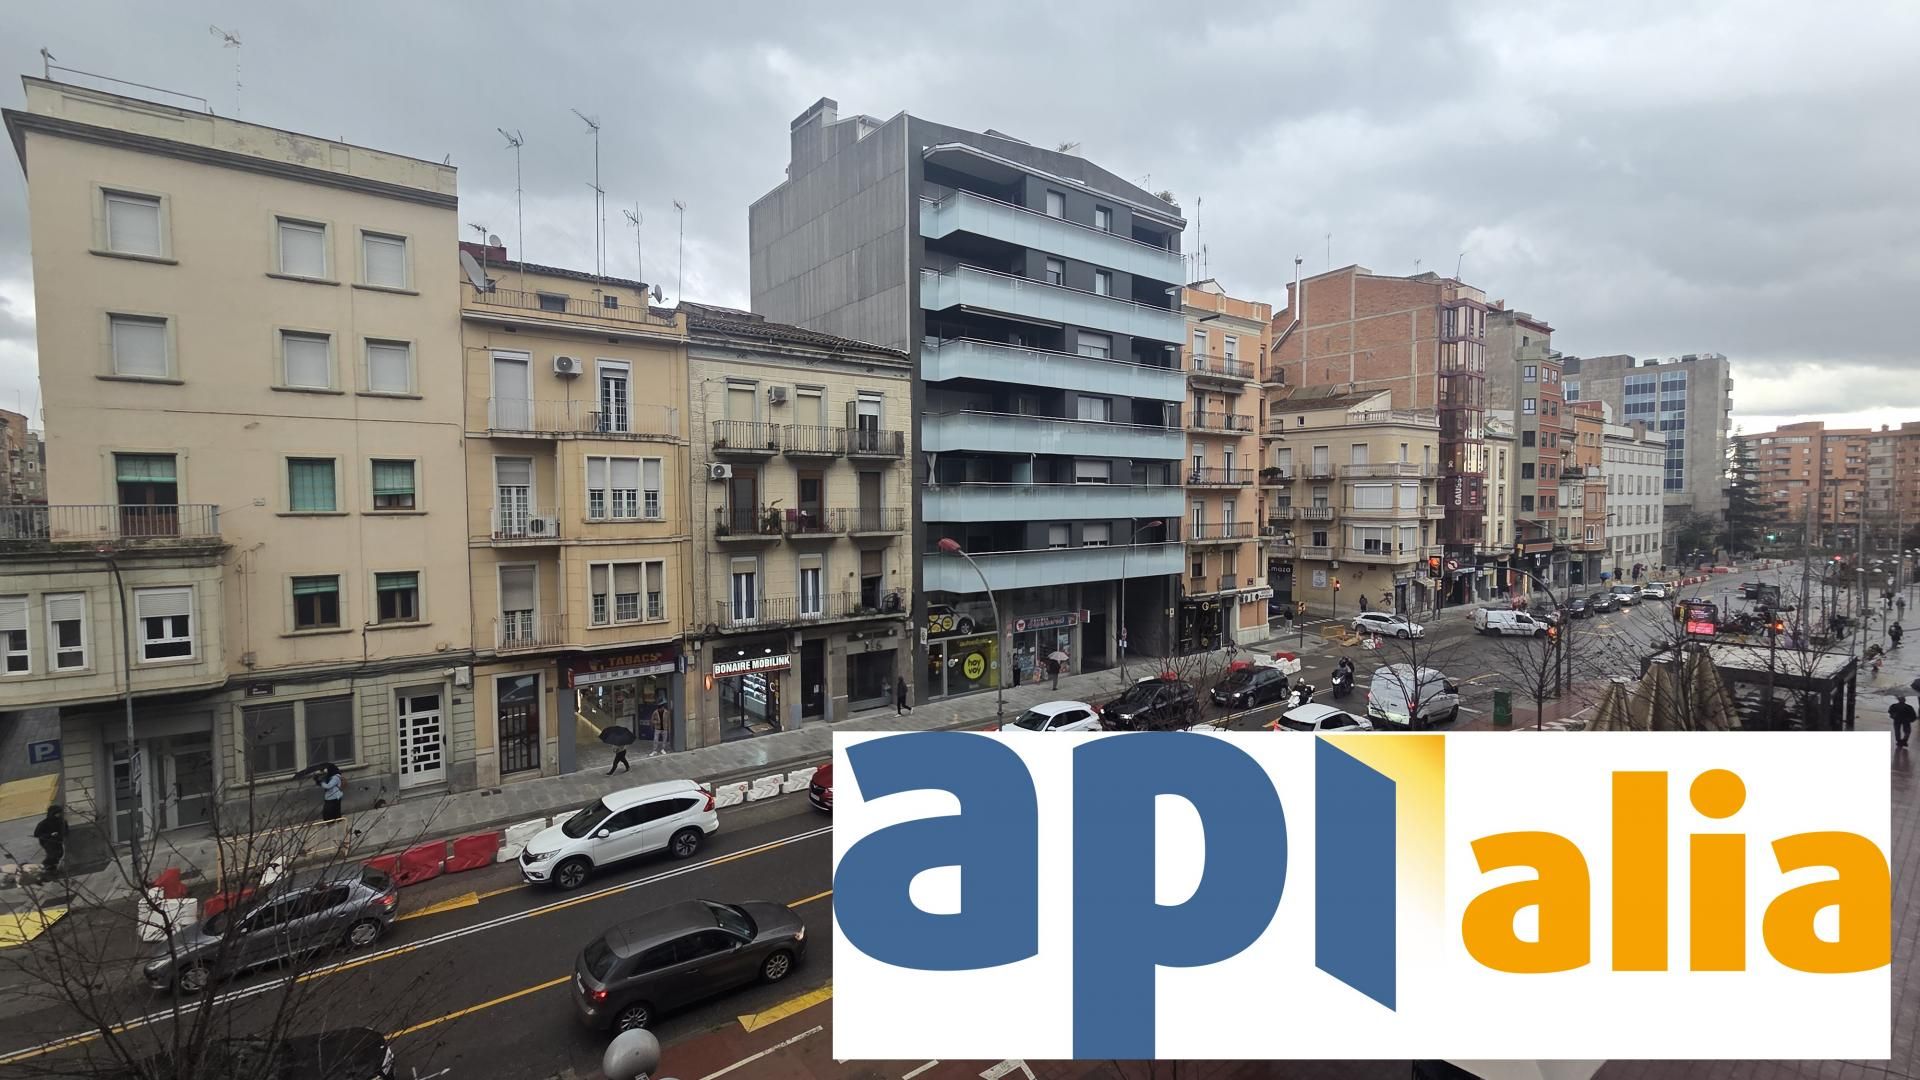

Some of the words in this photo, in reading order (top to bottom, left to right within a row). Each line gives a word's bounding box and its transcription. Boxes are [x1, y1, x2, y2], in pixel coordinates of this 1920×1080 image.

[715, 661, 751, 674] BONAIRE
[752, 656, 790, 669] MOBILINK
[35, 743, 55, 762] P
